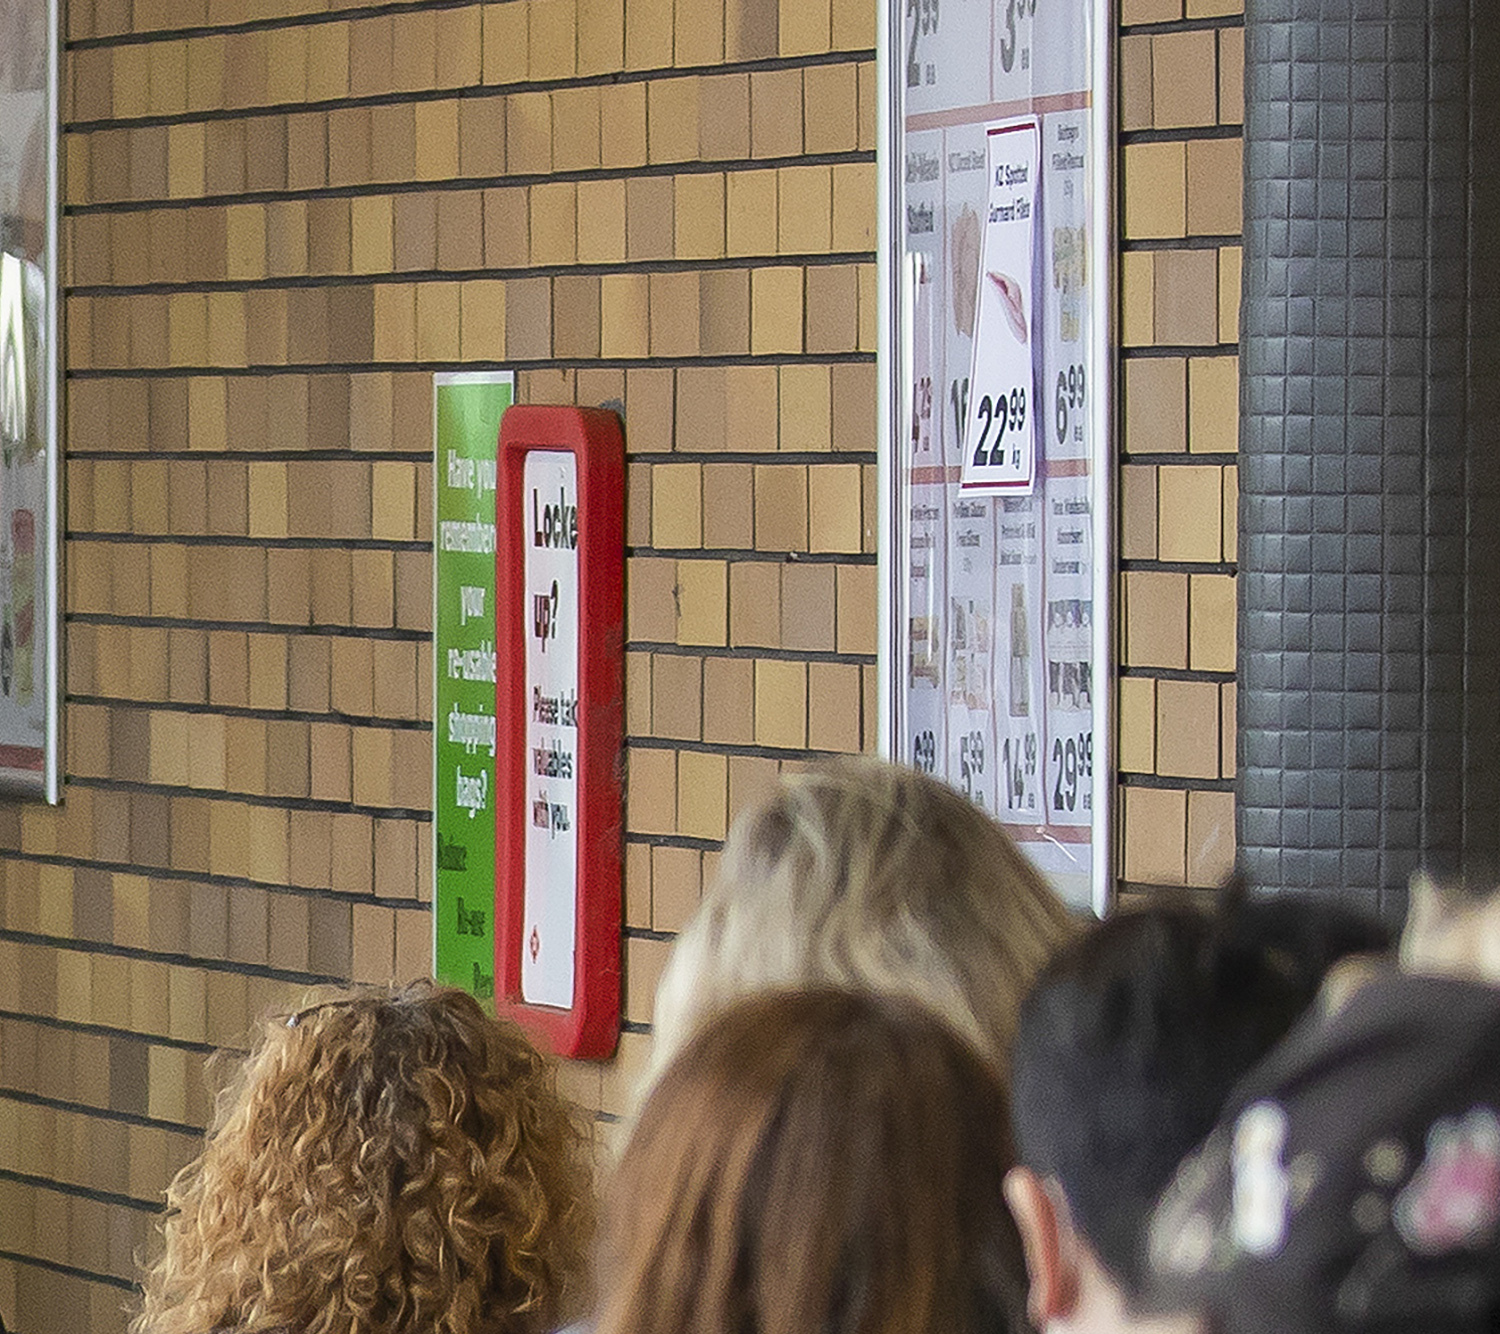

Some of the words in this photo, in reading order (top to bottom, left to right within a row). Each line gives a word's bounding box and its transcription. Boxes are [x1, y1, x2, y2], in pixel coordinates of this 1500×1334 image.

[447, 448, 474, 489] Have
[532, 486, 578, 550] Locke
[460, 586, 486, 626] your
[533, 579, 559, 653] up?
[448, 639, 497, 682] re-usable
[533, 686, 558, 723] Please
[560, 687, 578, 728] tak
[448, 702, 496, 757] shopping
[533, 736, 573, 779] valuables
[456, 764, 487, 819] bags?
[533, 789, 549, 829] with
